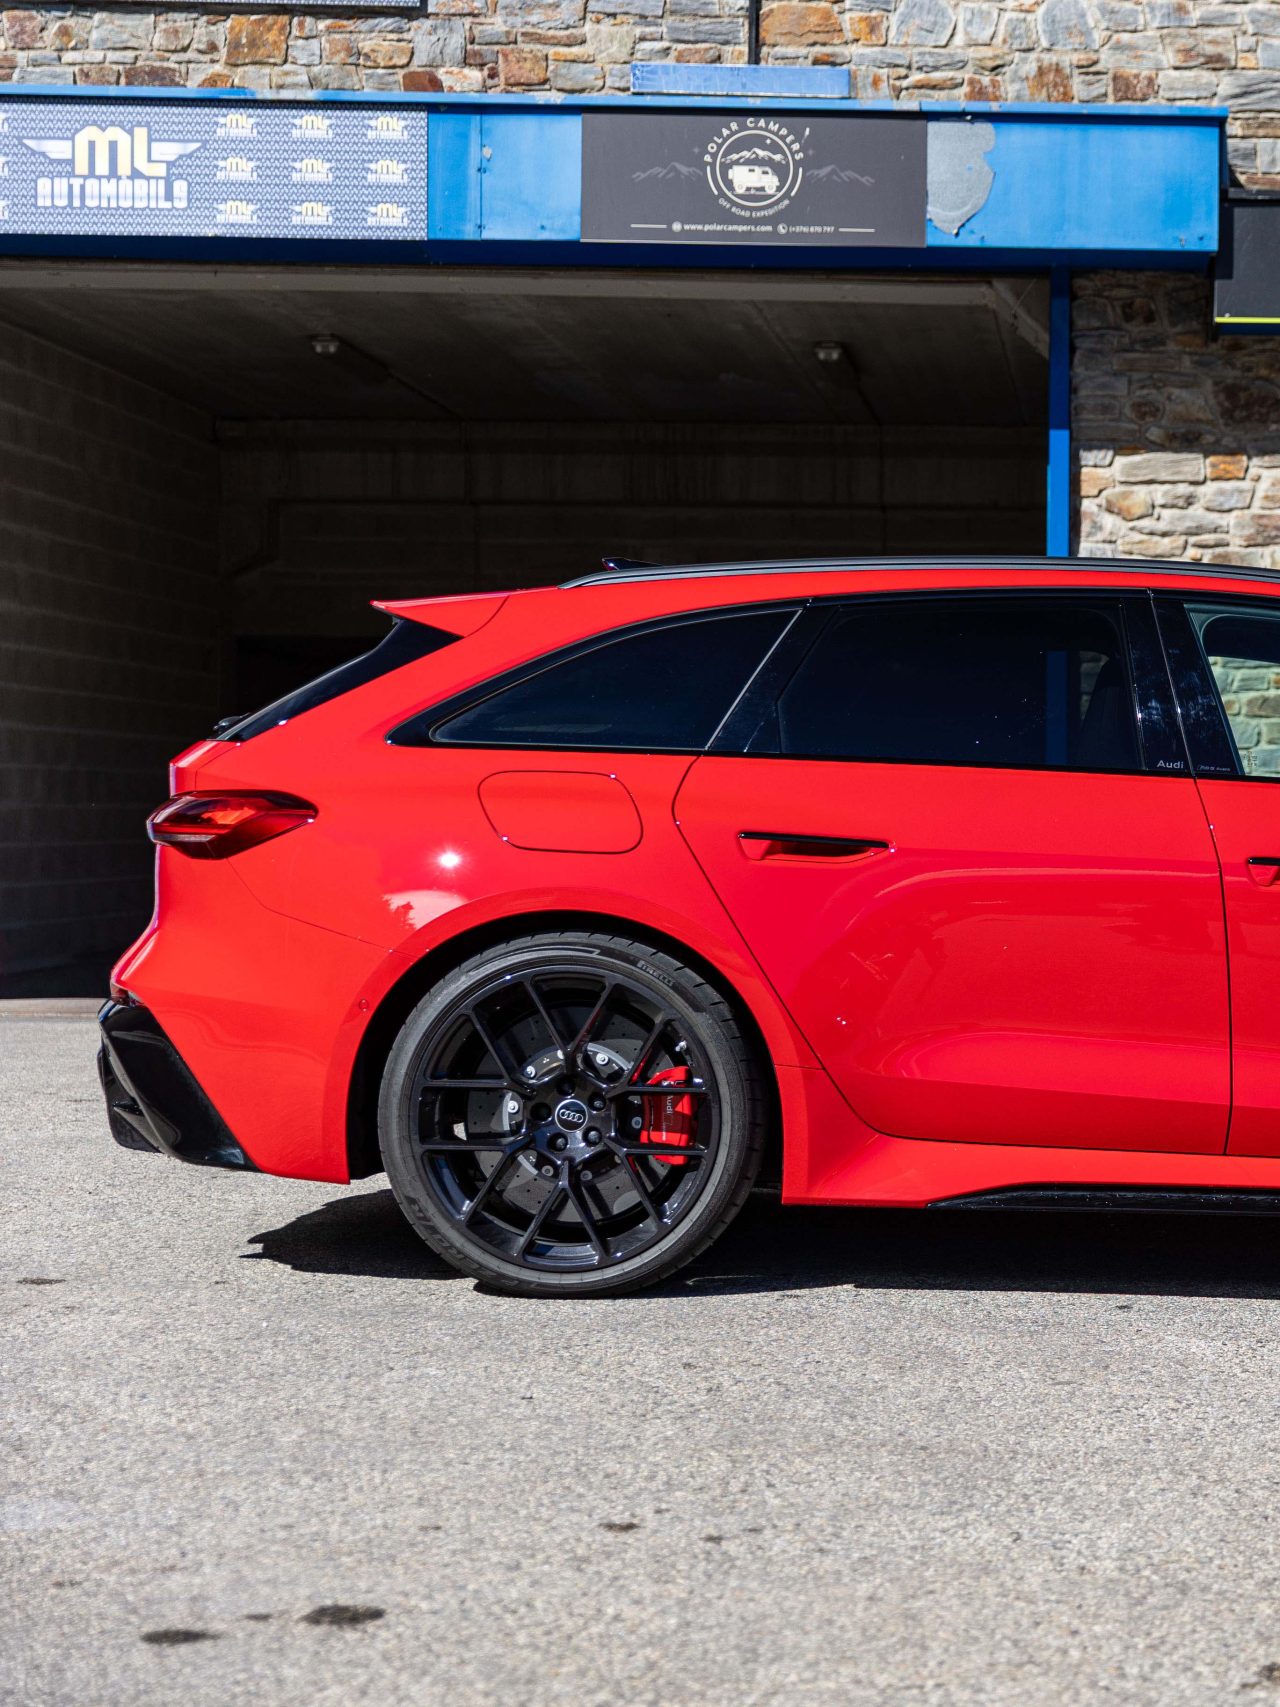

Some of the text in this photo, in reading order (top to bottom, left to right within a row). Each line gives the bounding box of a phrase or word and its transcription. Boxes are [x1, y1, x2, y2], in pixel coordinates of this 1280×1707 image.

[704, 117, 804, 163] POLAR CAMPERS
[74, 125, 167, 177] ML
[718, 197, 790, 218] OFF ROAD EXPEDITION
[683, 222, 773, 233] www.polarcampers.com
[1156, 759, 1184, 769] Audi
